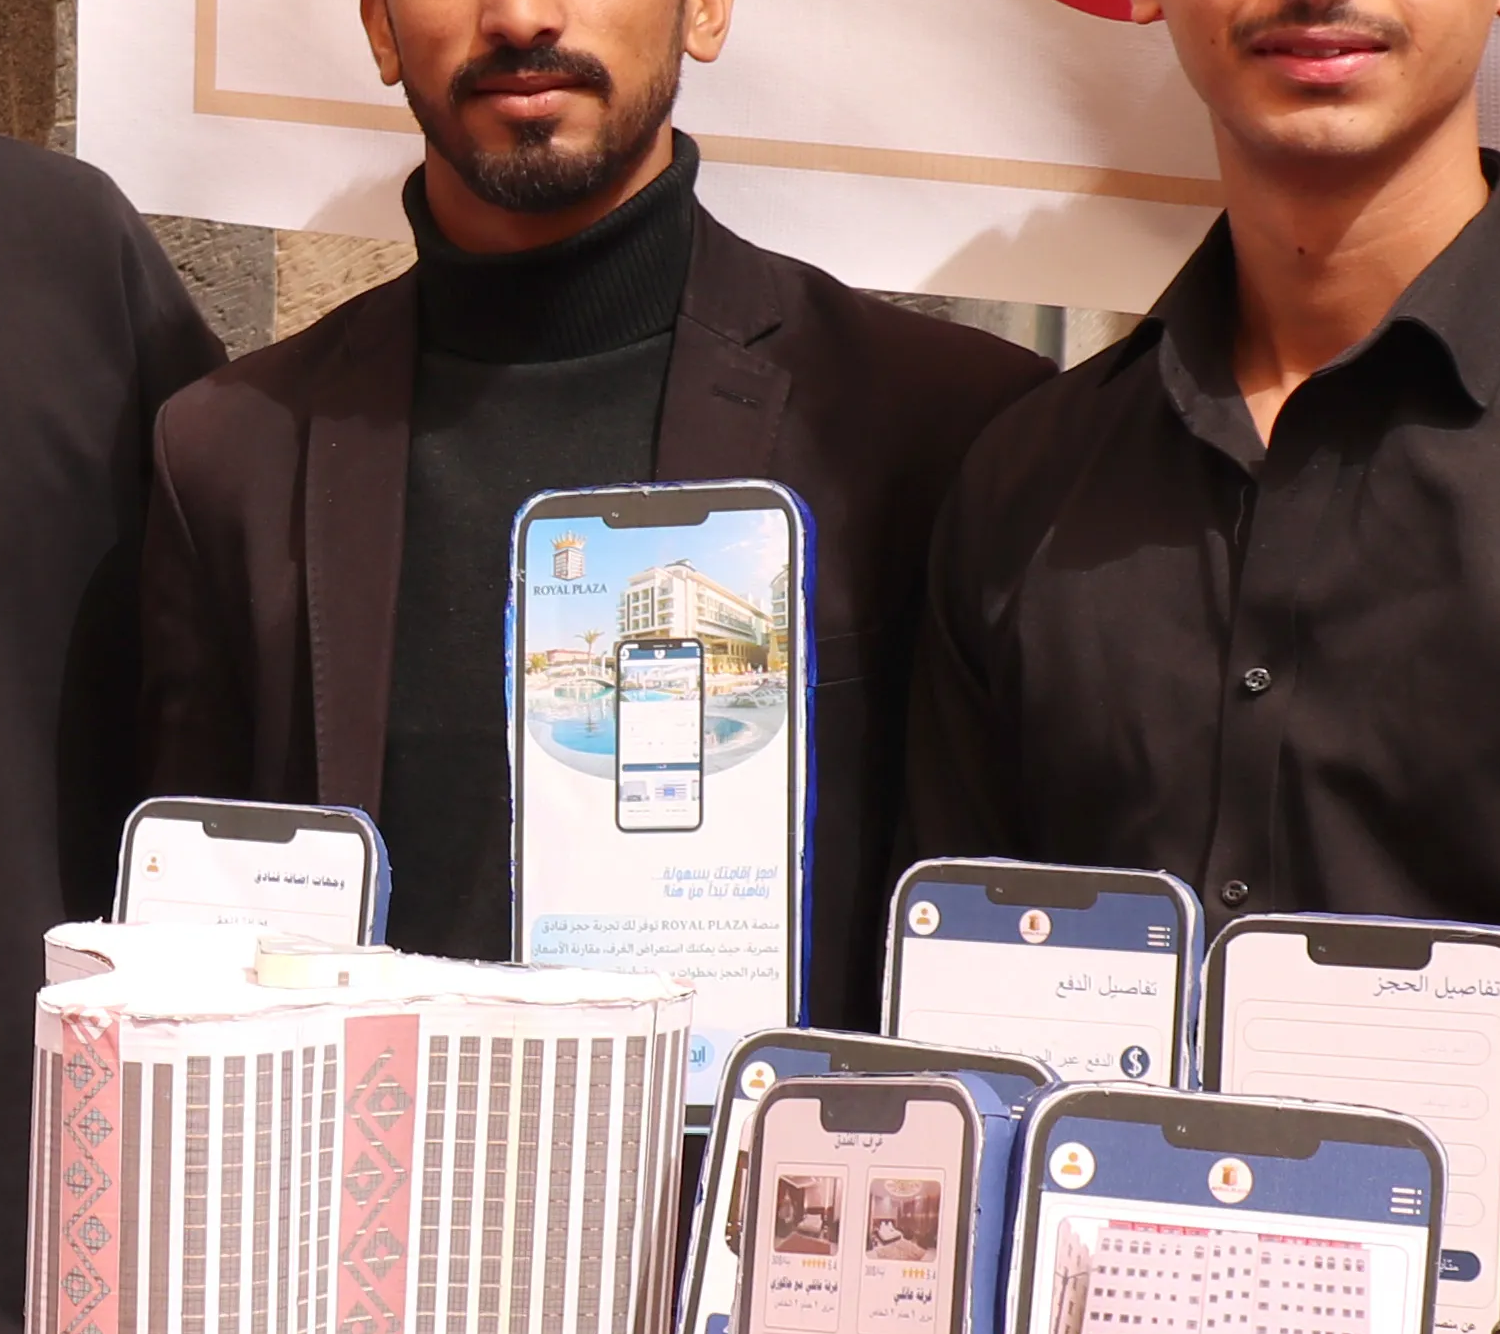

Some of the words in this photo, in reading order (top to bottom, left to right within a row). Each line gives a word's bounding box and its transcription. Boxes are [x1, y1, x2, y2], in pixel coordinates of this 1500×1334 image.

[533, 585, 570, 596] ROYAL
[572, 583, 608, 594] PLAZA
[661, 920, 705, 931] ROYAL
[708, 920, 749, 931] PLAZA
[1055, 973, 1092, 998] الدفع
[1099, 975, 1157, 998] تفاصيل
[1373, 975, 1428, 997] الحجز
[1434, 977, 1500, 999] تفاصيل
